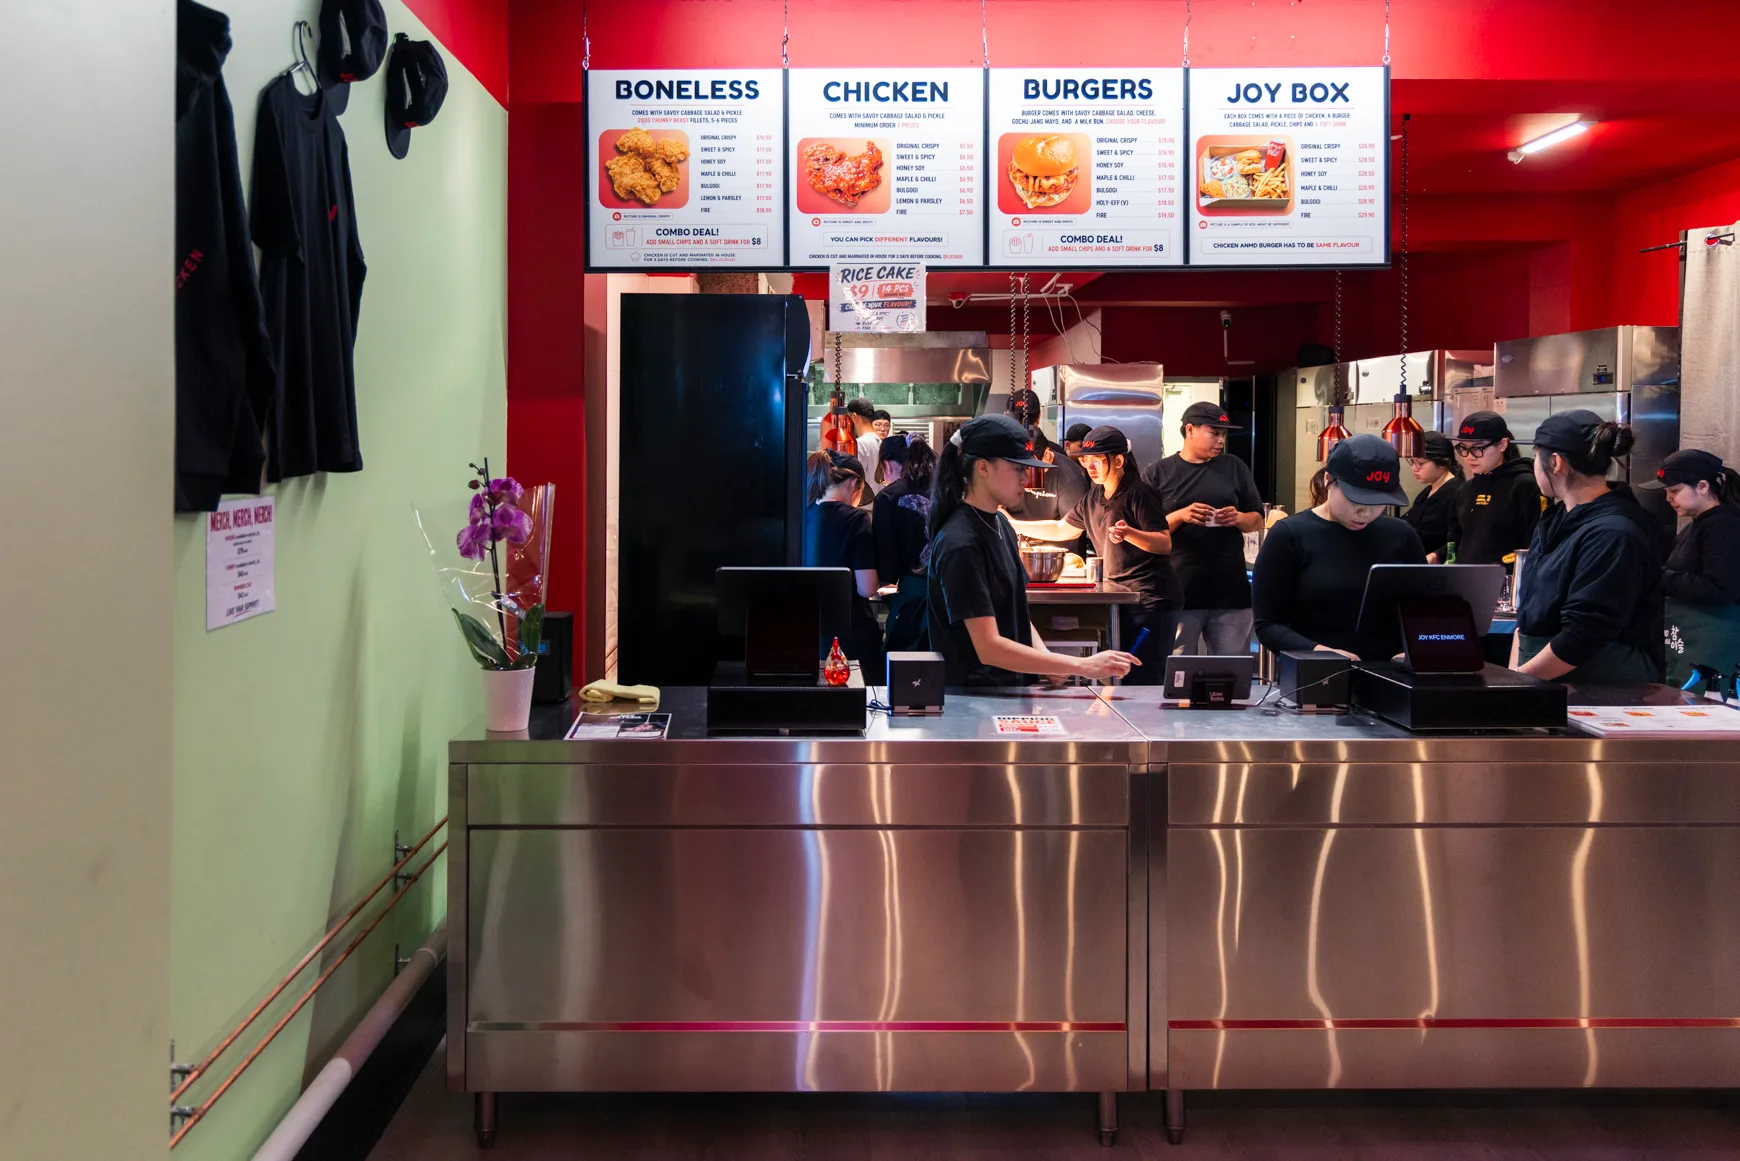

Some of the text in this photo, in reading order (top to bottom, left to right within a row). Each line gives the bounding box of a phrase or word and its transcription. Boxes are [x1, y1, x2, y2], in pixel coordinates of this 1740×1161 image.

[616, 80, 758, 100] BONELESS
[824, 82, 948, 102] CHICKEN
[1024, 79, 1152, 100] BURGERS
[1227, 83, 1349, 103] JOY BOX
[656, 228, 719, 236] COMBO DEAL!
[1060, 235, 1122, 244] COMBO DEAL!
[841, 266, 915, 284] RICE CAKE
[894, 285, 909, 293] PCS
[1366, 471, 1390, 482] JOY
[1671, 625, 1684, 653] 참이슬
